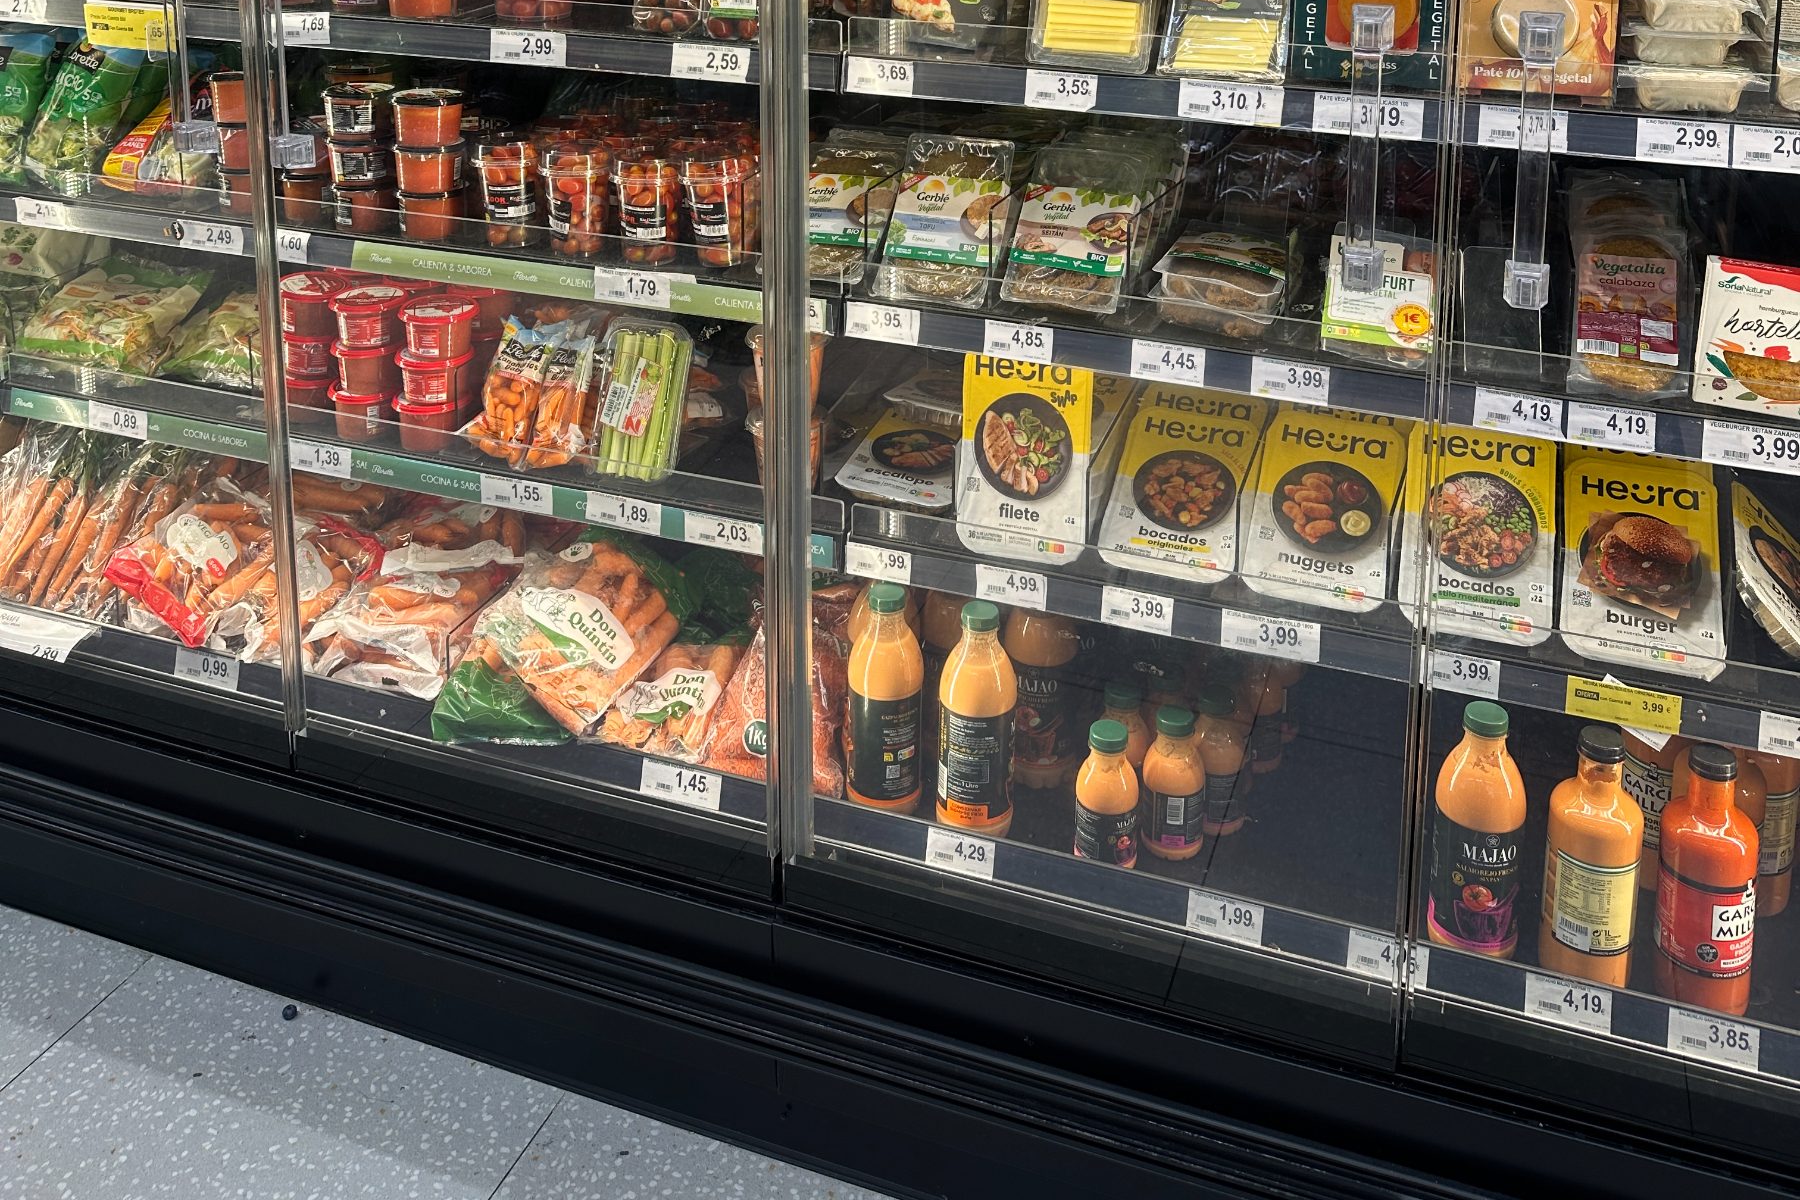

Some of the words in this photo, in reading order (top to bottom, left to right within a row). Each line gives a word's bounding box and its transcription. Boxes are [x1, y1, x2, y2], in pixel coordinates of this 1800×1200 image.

[1474, 65, 1502, 78] Paté
[916, 191, 950, 204] Gerblé
[1043, 202, 1076, 213] Gerblé
[962, 244, 977, 252] BIO
[1090, 253, 1106, 262] BIO
[412, 258, 447, 270] CALIENTA
[456, 264, 493, 277] SABOREA
[1592, 257, 1667, 277] Vegetalia
[1599, 274, 1656, 289] calabaza
[714, 297, 753, 310] CALIENTA
[1403, 313, 1420, 324] 1€
[1710, 421, 1750, 432] VEGEBURGER
[183, 428, 210, 441] COCINA
[217, 434, 248, 448] SABOREA
[420, 474, 451, 486] COCINA
[865, 466, 935, 487] escalope
[998, 502, 1041, 523] filete
[1138, 525, 1208, 547] bocados
[1278, 550, 1355, 575] nuggets
[1438, 573, 1516, 597] bocados
[590, 607, 618, 641] Don
[1605, 609, 1679, 635] burger
[567, 611, 617, 666] Quintín
[671, 673, 706, 687] Don
[1576, 689, 1599, 700] OFERTA
[1462, 842, 1517, 863] MAJAO
